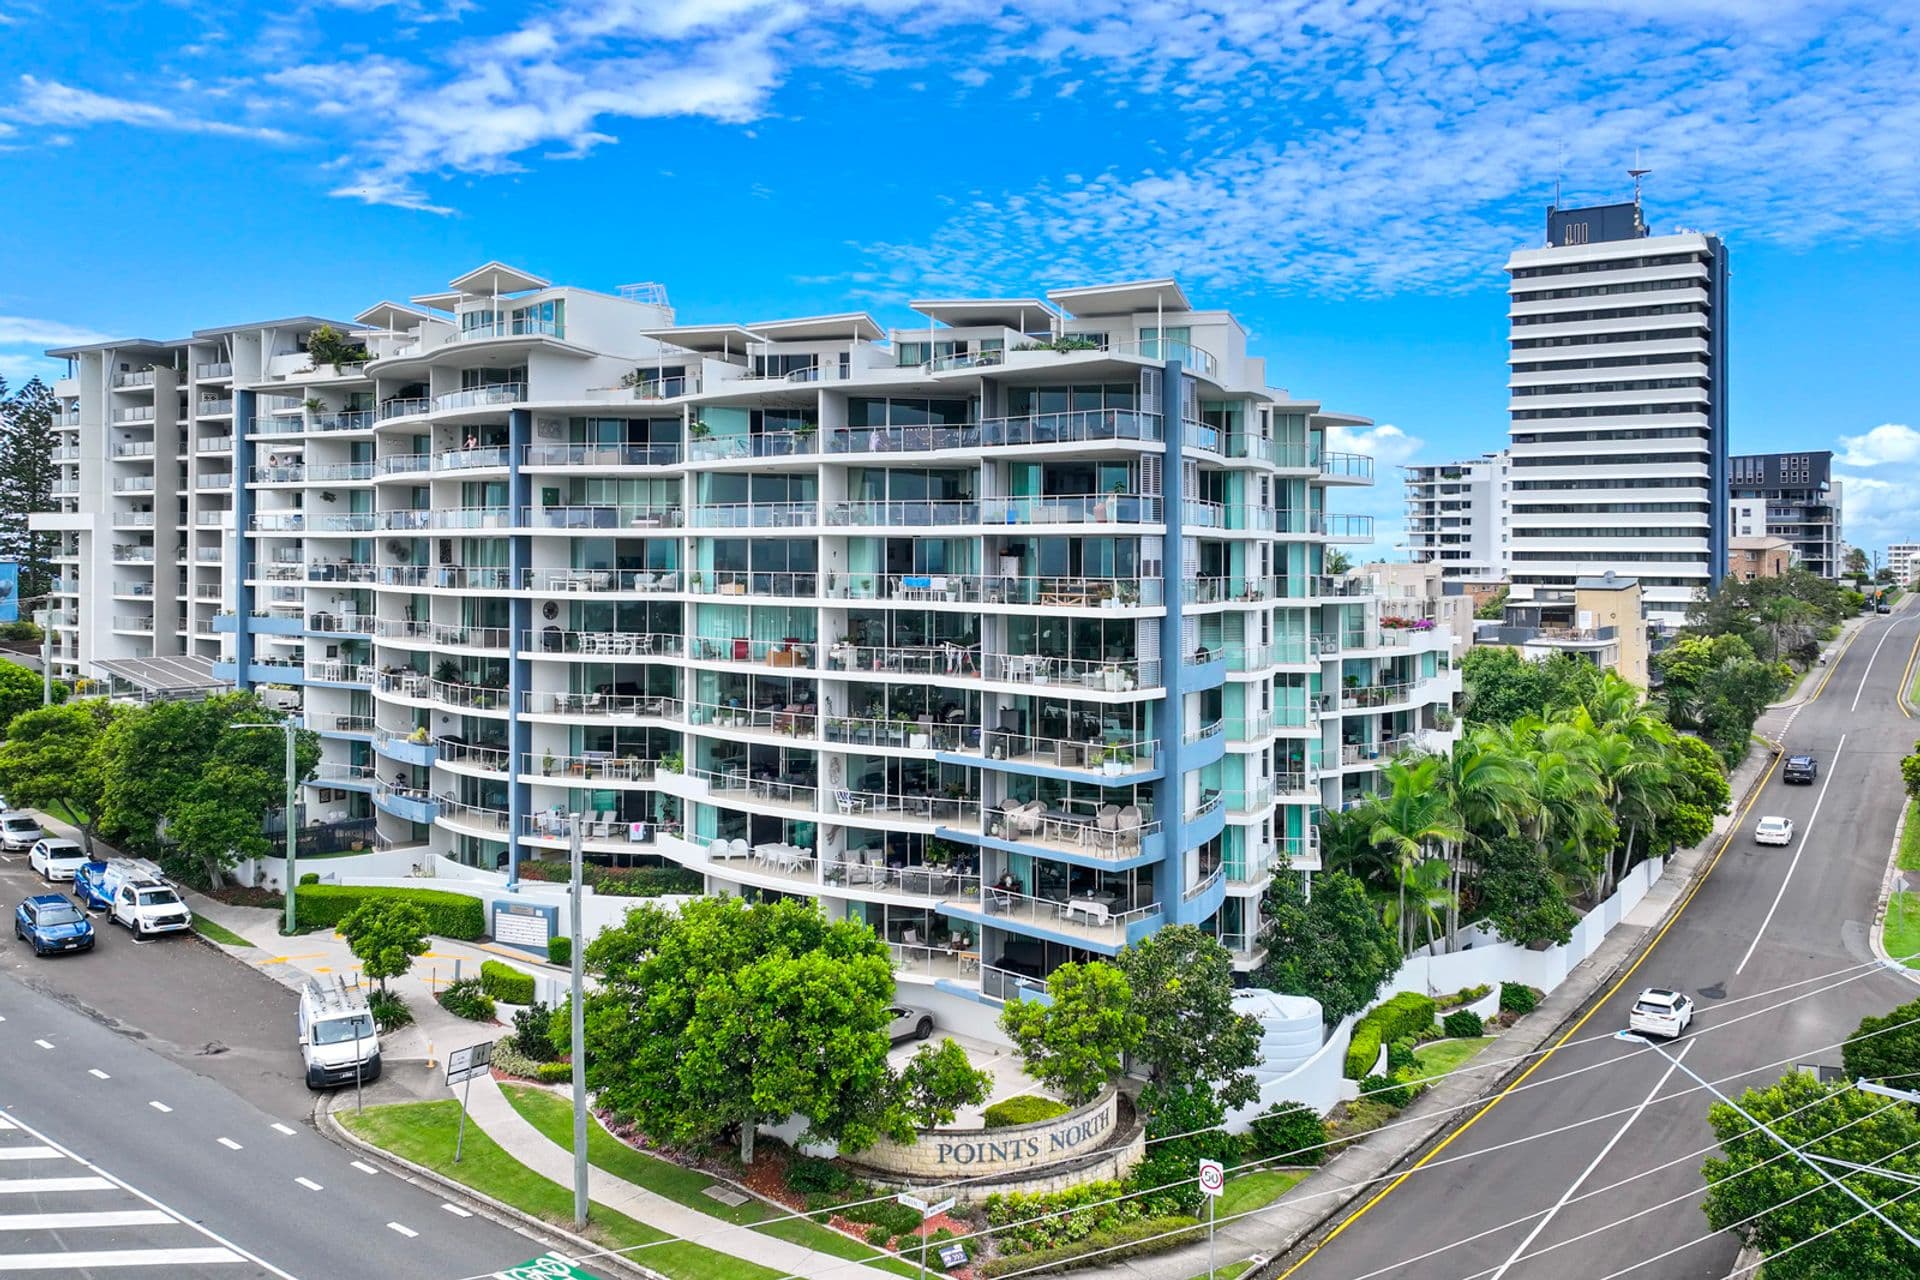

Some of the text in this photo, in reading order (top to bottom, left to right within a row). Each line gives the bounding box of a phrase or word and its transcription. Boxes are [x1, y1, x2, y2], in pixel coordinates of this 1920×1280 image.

[937, 1107, 1110, 1164] POINTS NORTH
[1205, 1171, 1219, 1184] 50
